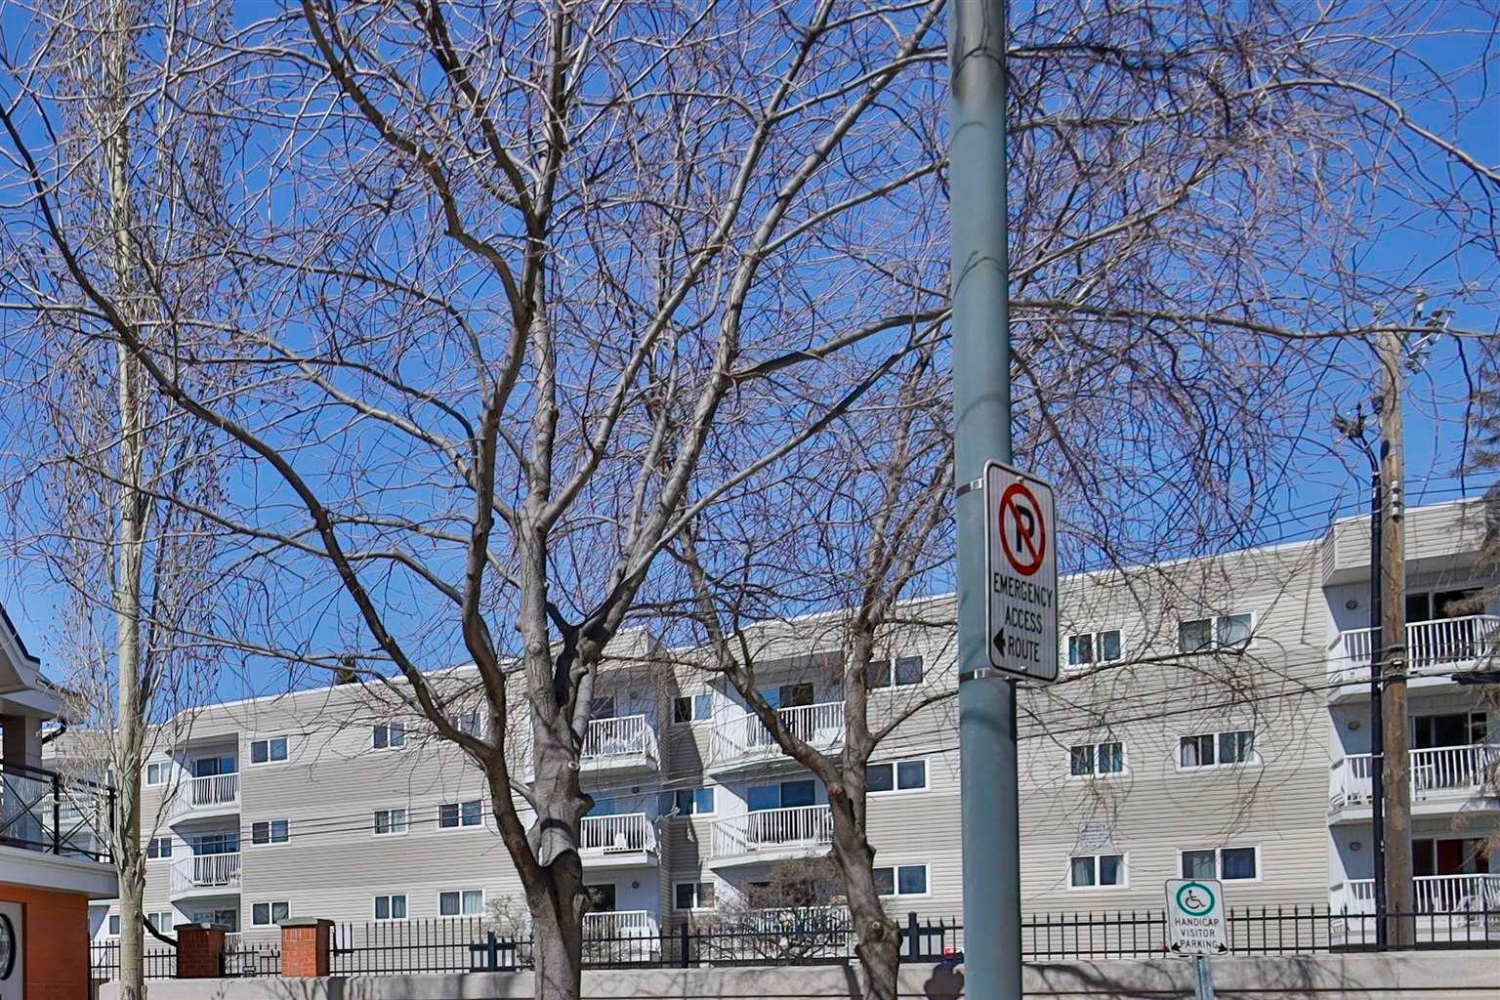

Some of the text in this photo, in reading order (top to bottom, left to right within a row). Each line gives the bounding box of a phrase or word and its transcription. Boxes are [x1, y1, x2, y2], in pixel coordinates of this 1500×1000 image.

[994, 572, 1053, 608] EMERGENCY
[1005, 605, 1043, 634] ACCESS
[1008, 635, 1040, 662] ROUTE
[1174, 918, 1220, 927] HANDICAP
[1180, 929, 1215, 938] VISITOR
[1180, 940, 1219, 949] PARKING
